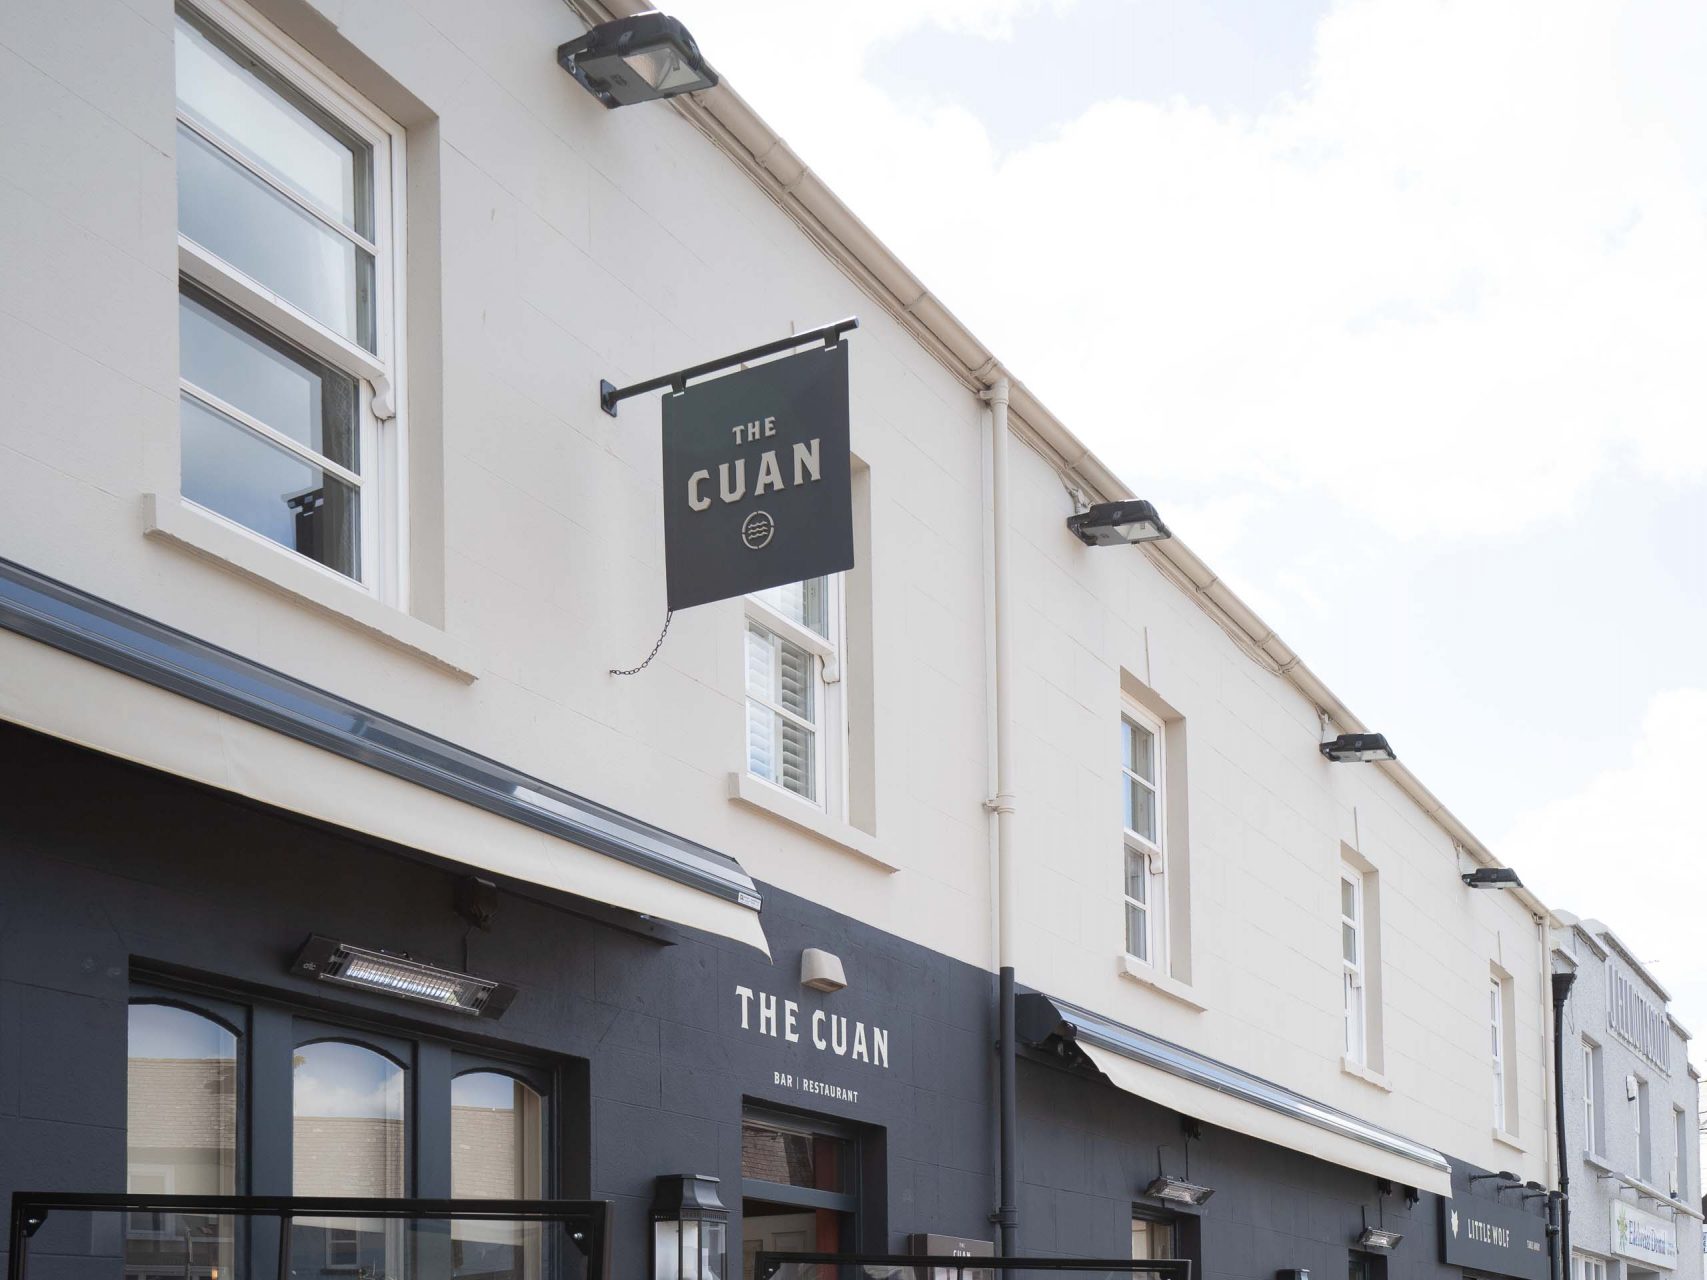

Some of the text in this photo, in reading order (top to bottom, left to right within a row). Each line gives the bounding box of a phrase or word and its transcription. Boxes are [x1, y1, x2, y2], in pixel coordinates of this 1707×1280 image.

[732, 416, 777, 446] THE
[687, 438, 822, 512] CUAN
[735, 985, 889, 1069] THE CUAN
[773, 1071, 859, 1103] BAR RESTAURANT
[1467, 1218, 1491, 1244] LITTLE
[1491, 1225, 1510, 1248] WOLF
